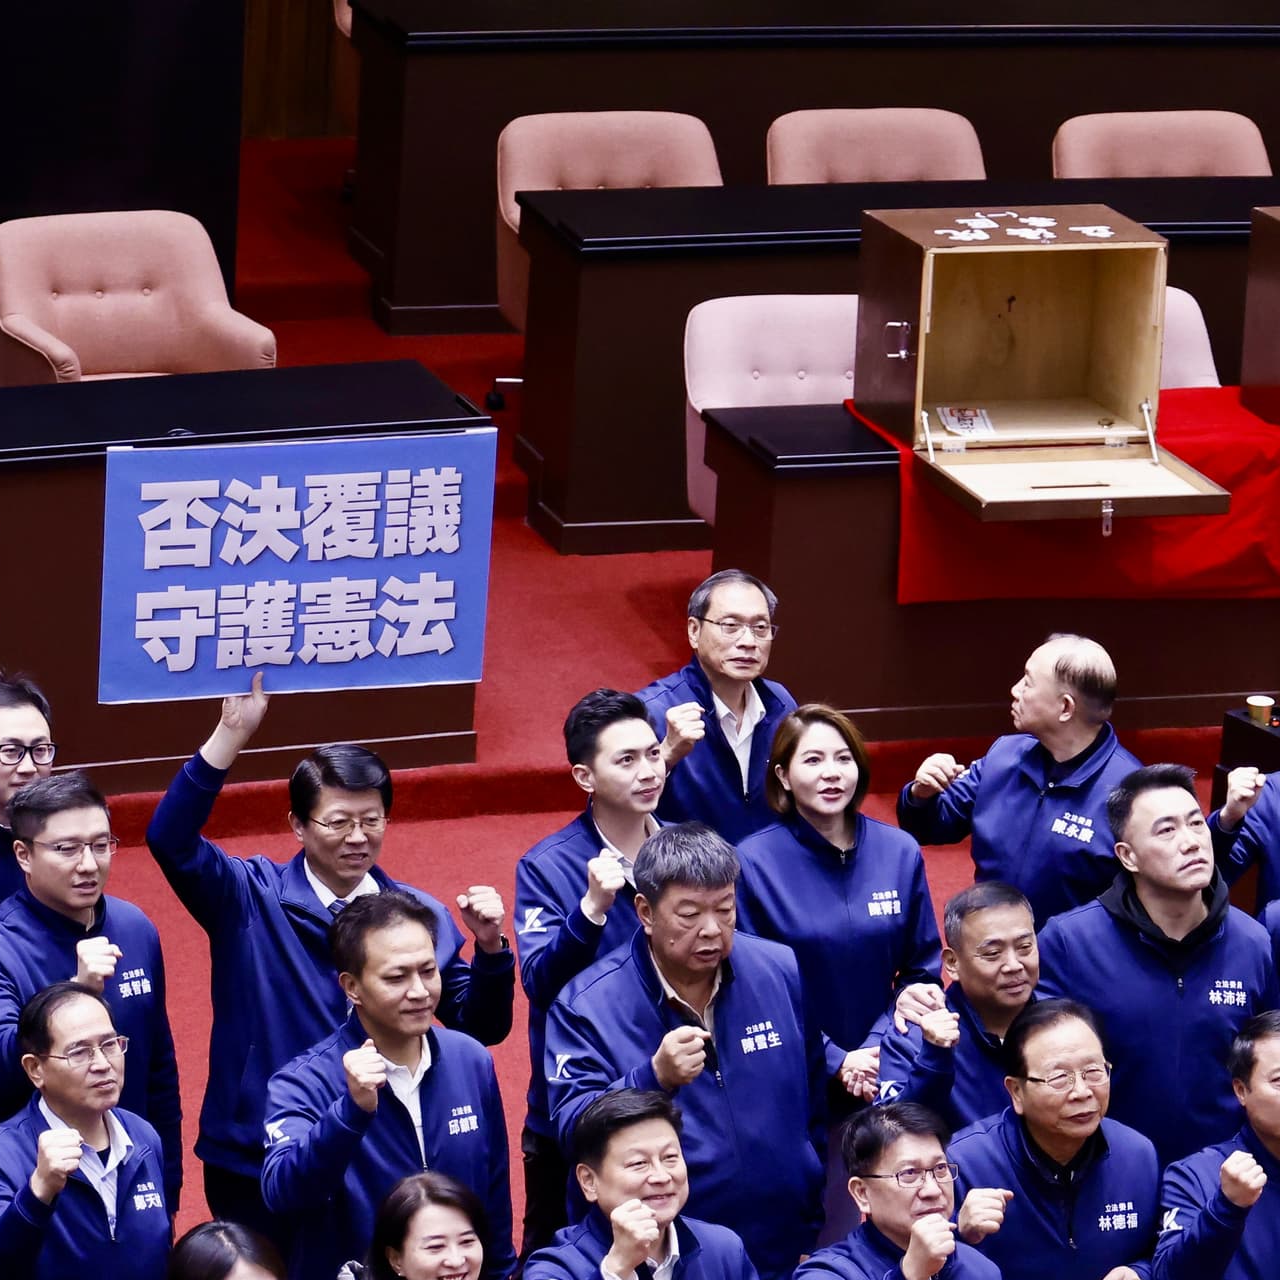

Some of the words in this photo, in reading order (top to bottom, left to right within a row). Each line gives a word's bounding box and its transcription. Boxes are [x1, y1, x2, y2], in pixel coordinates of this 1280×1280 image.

[138, 467, 462, 570] 否決覆議
[135, 572, 455, 672] 守護憲法
[1215, 980, 1243, 989] 立法委員
[1209, 989, 1247, 1006] 林沛祥
[740, 1032, 783, 1055] 陳雪生
[1105, 1202, 1133, 1212] 立法委員
[1098, 1213, 1138, 1231] 林德福
